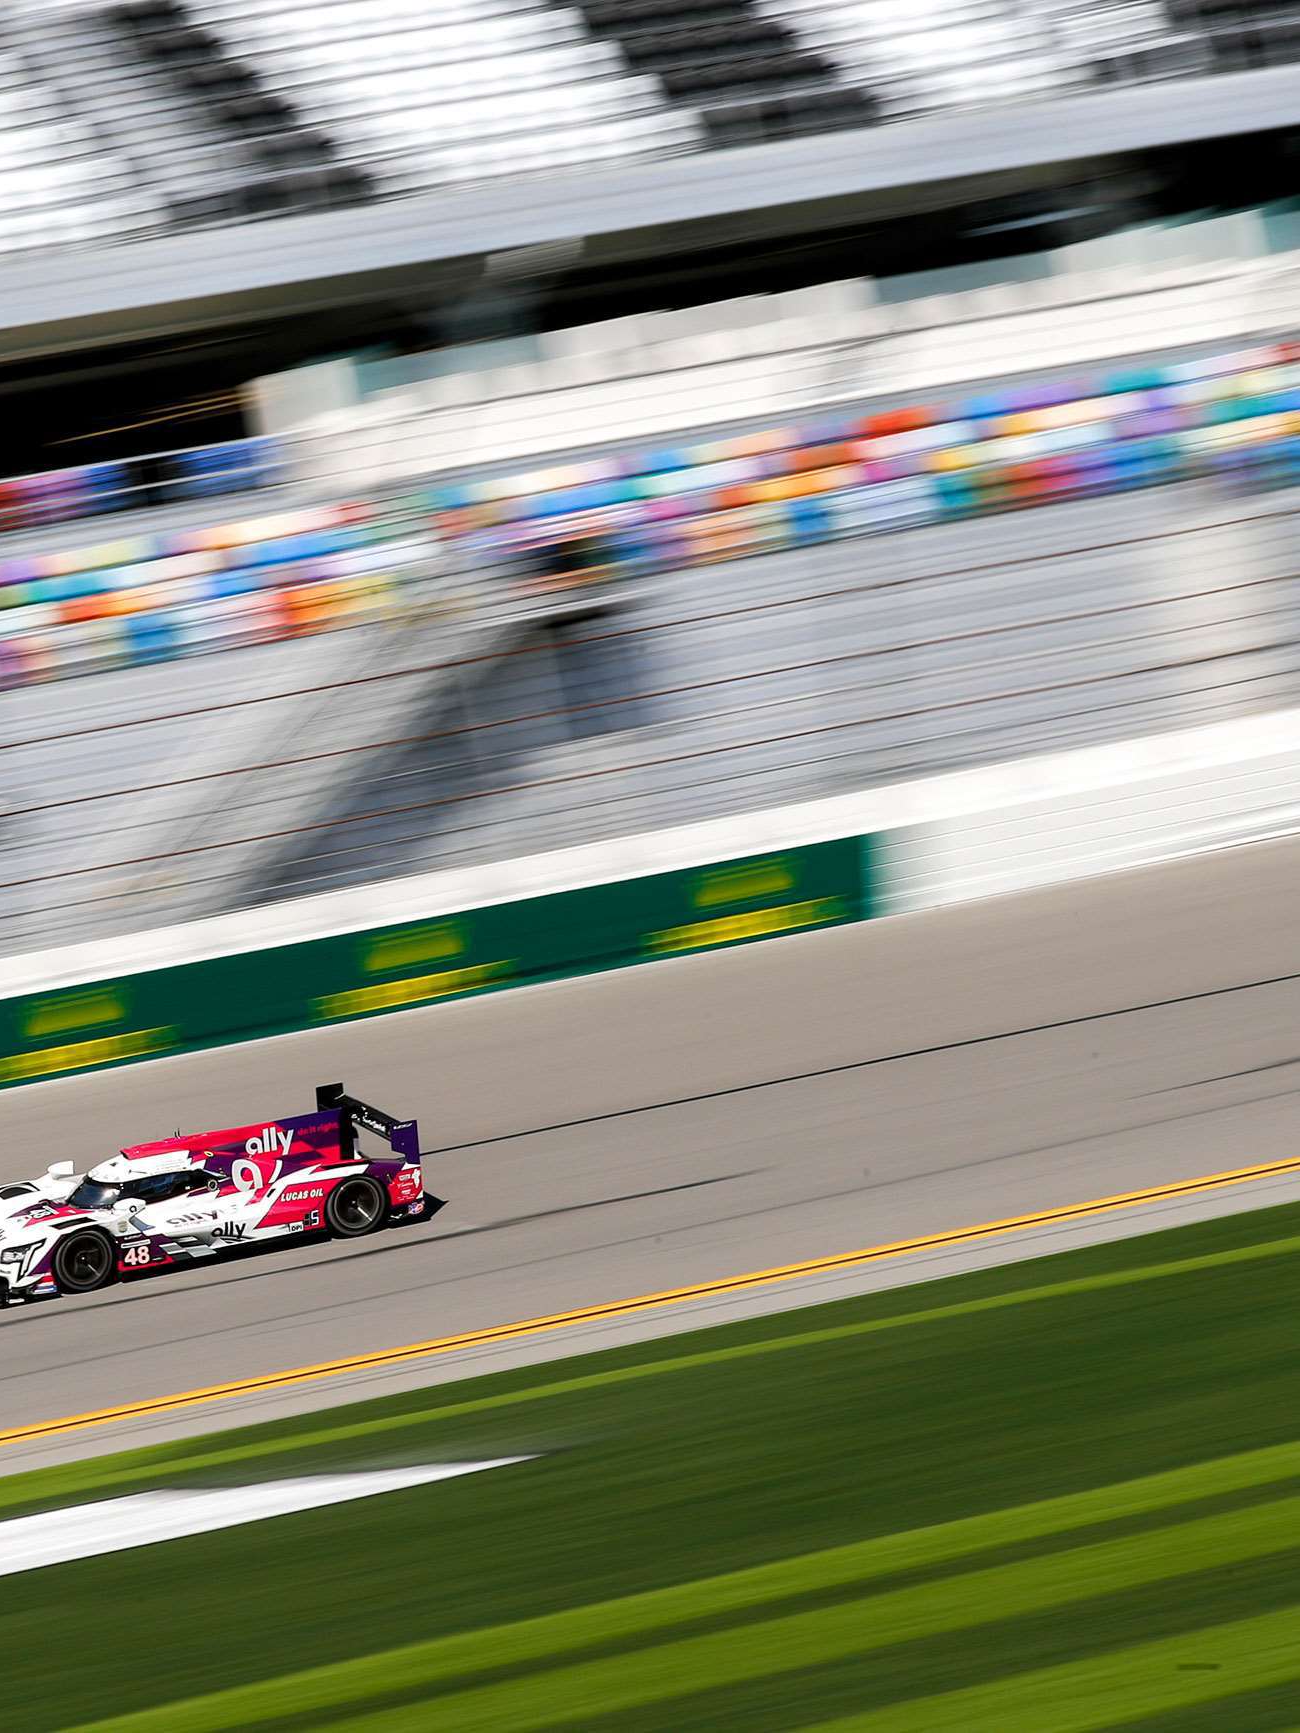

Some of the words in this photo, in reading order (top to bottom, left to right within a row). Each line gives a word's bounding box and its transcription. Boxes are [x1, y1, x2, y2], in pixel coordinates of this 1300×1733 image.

[245, 1126, 294, 1156] ally
[281, 1190, 309, 1202] LUCAS
[310, 1188, 324, 1199] OIL
[211, 1221, 246, 1240] ally
[124, 1246, 150, 1265] 48
